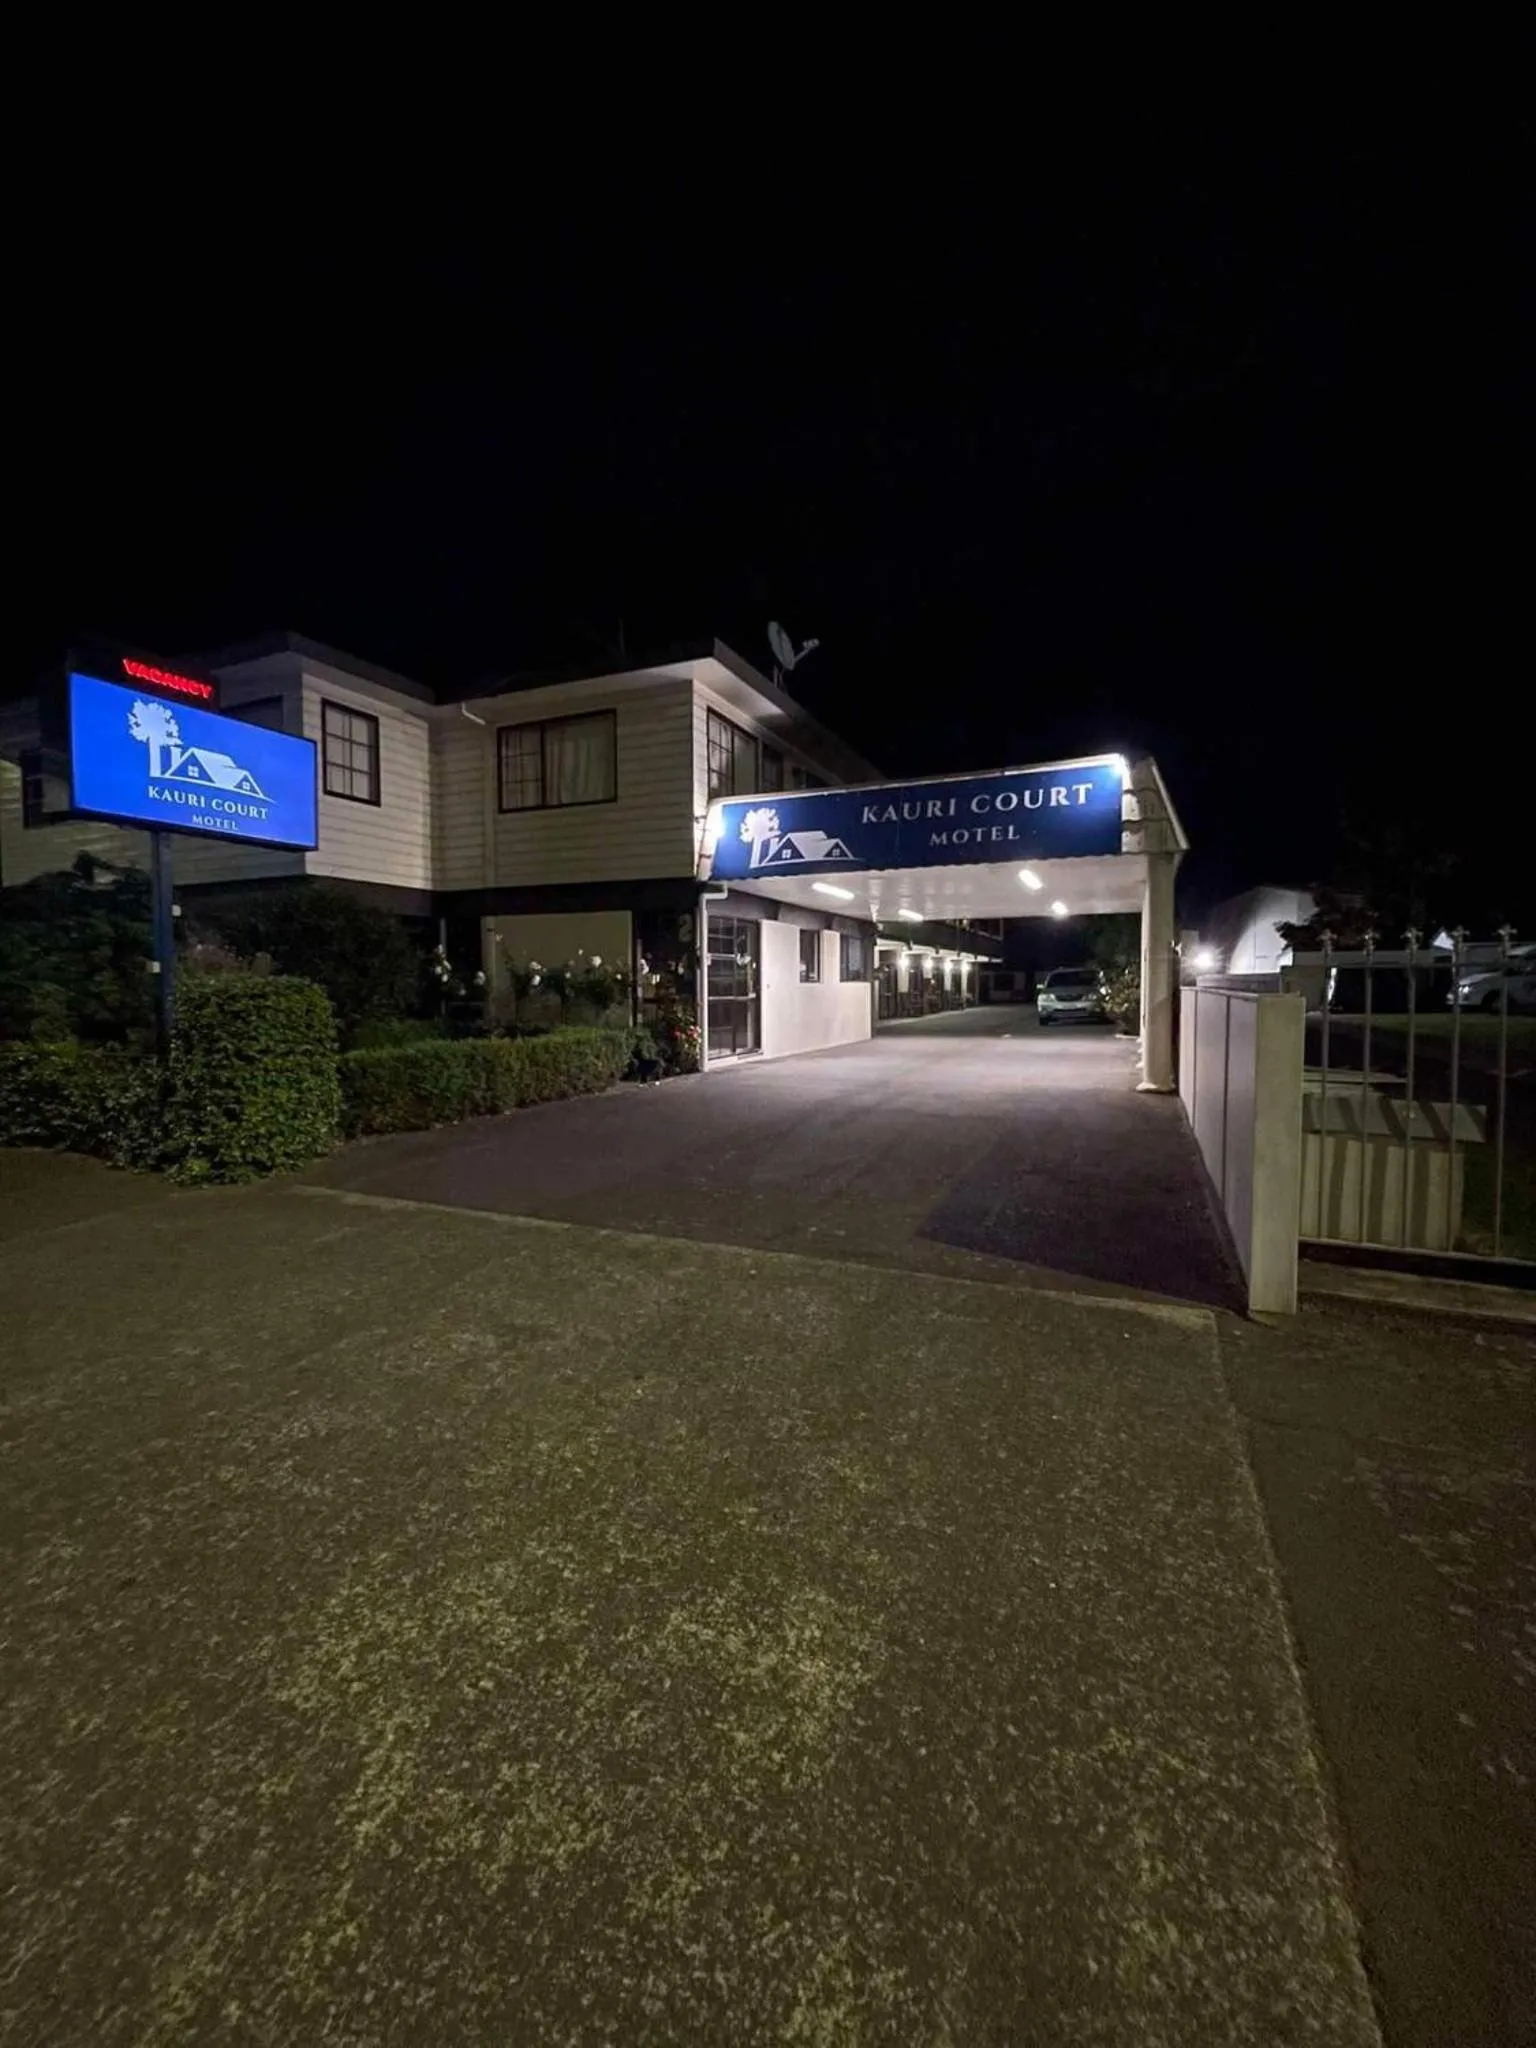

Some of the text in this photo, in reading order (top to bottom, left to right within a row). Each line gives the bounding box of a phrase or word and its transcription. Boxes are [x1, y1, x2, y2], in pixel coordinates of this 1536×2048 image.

[122, 659, 214, 699] VACANCY
[148, 786, 269, 820] KAURI COURT
[862, 783, 1093, 824] KAURI COURT
[192, 815, 239, 831] MOTEL
[929, 825, 1020, 846] MOTEL
